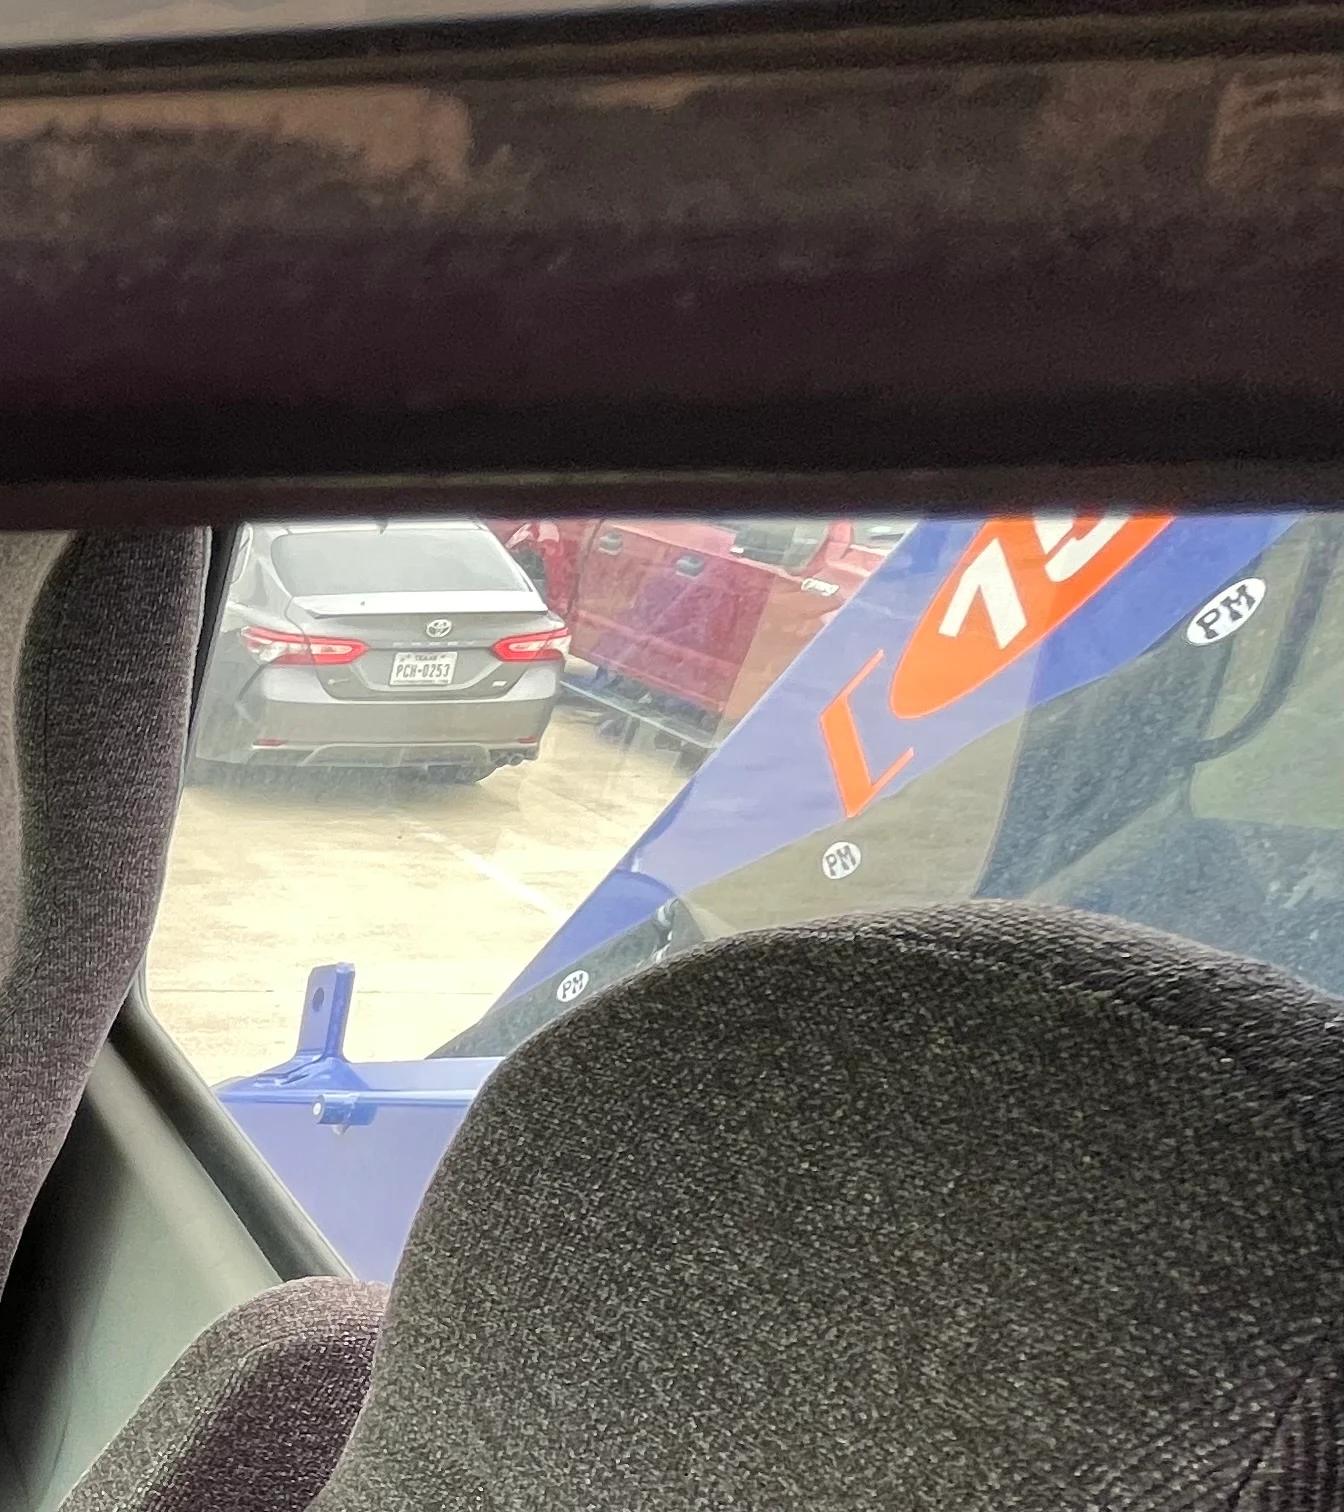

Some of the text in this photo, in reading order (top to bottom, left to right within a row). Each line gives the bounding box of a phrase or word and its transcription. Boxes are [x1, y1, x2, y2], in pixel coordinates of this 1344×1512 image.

[1195, 583, 1257, 640] PM
[825, 844, 857, 877] PM
[561, 972, 584, 999] PM
